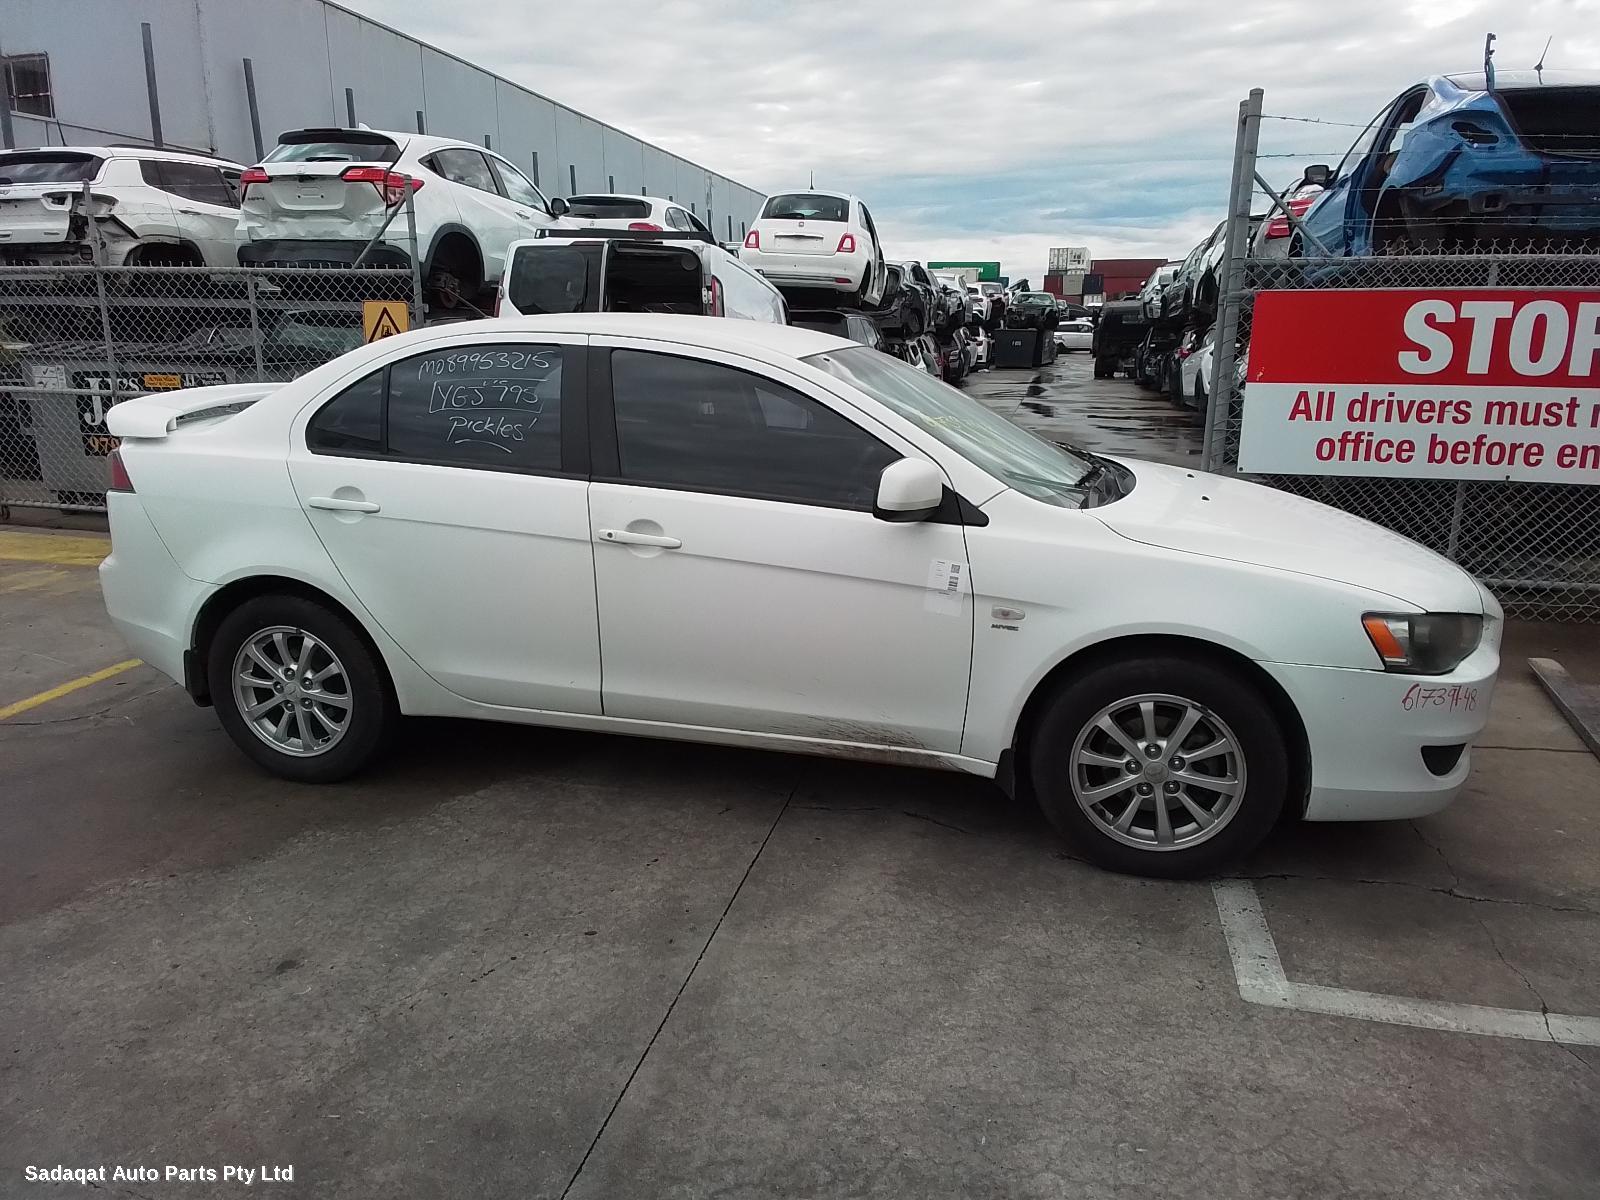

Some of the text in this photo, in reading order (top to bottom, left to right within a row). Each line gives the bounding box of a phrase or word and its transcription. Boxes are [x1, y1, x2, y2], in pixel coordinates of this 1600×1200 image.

[1289, 390, 1336, 422] All
[1347, 391, 1472, 424] drivers
[1484, 396, 1581, 428] must
[1315, 431, 1416, 464] office
[1427, 433, 1544, 466] before
